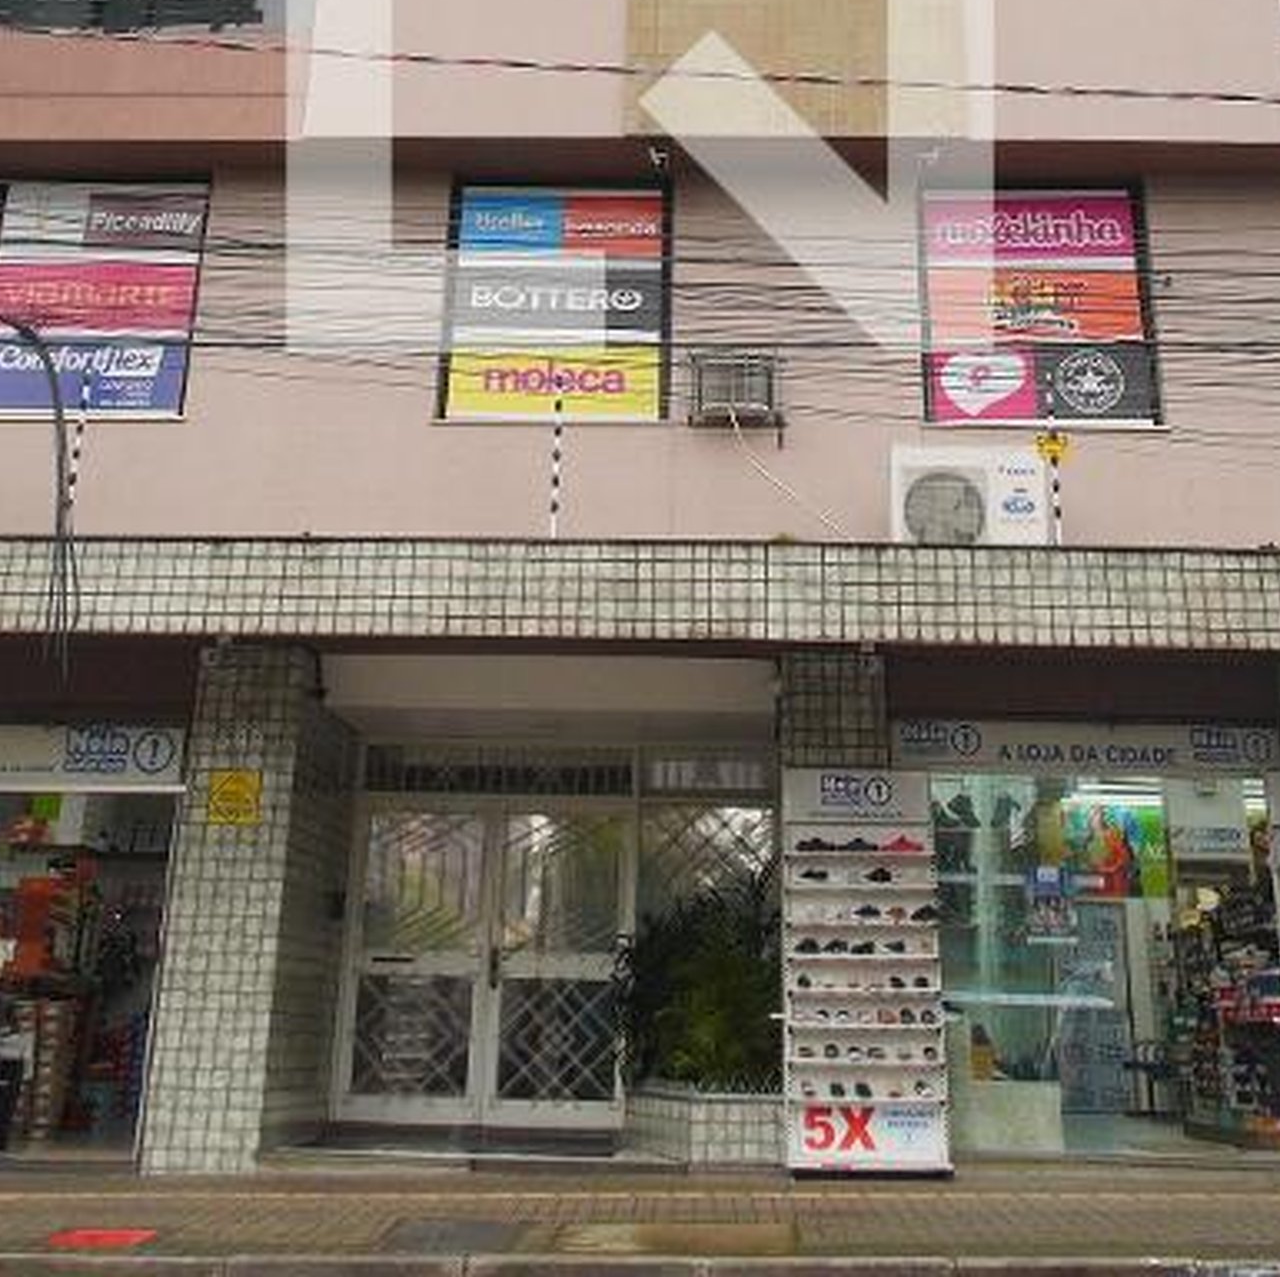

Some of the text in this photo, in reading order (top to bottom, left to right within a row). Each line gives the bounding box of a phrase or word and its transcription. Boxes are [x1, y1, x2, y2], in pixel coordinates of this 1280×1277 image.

[469, 285, 644, 312] BOTTERO
[483, 357, 626, 394] moleca
[803, 1105, 876, 1152] 5X
